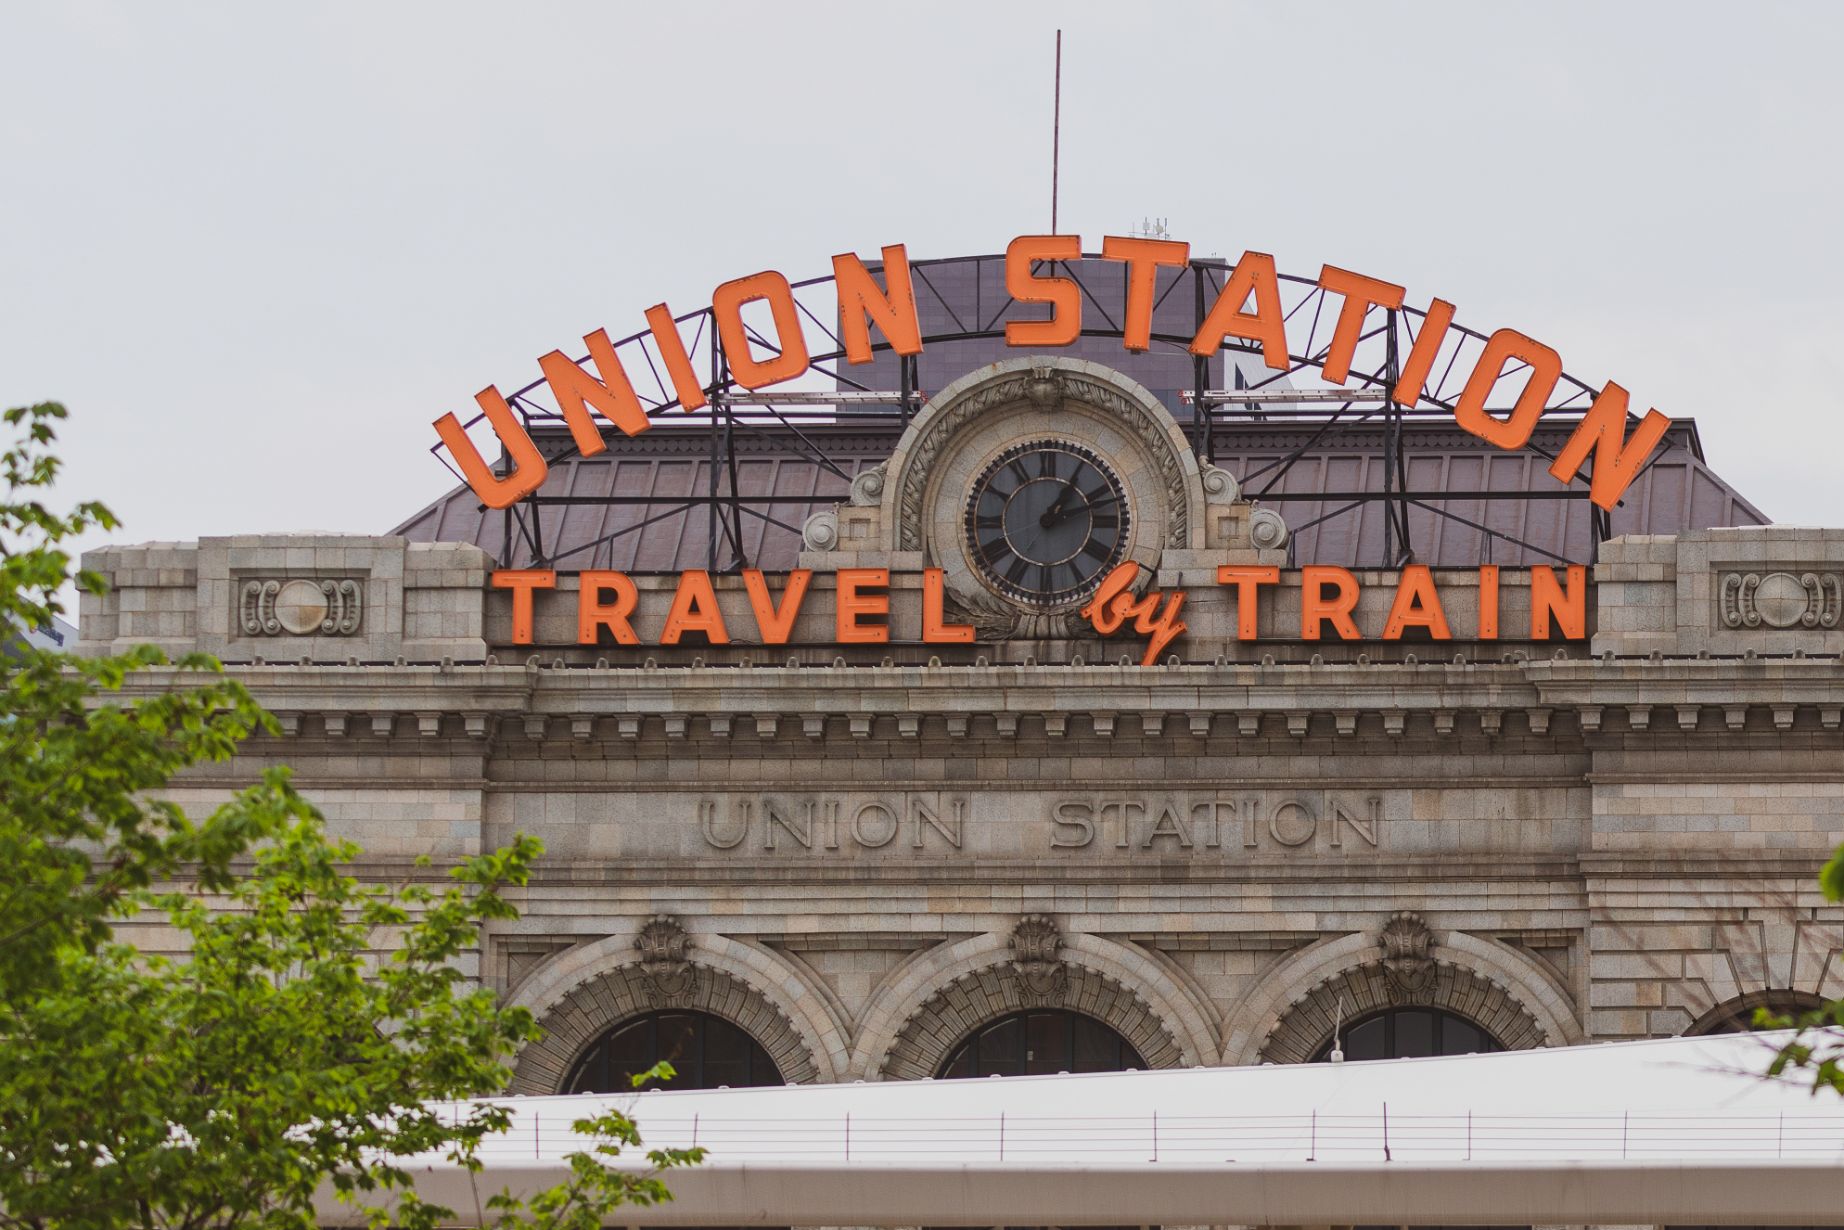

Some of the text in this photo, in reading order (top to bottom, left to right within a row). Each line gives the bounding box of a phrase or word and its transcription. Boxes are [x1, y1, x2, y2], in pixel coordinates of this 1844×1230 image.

[432, 234, 1672, 513] UNION STATION
[491, 560, 1587, 666] TRAVEL by TRAIN
[702, 800, 1380, 849] UNION STATION
